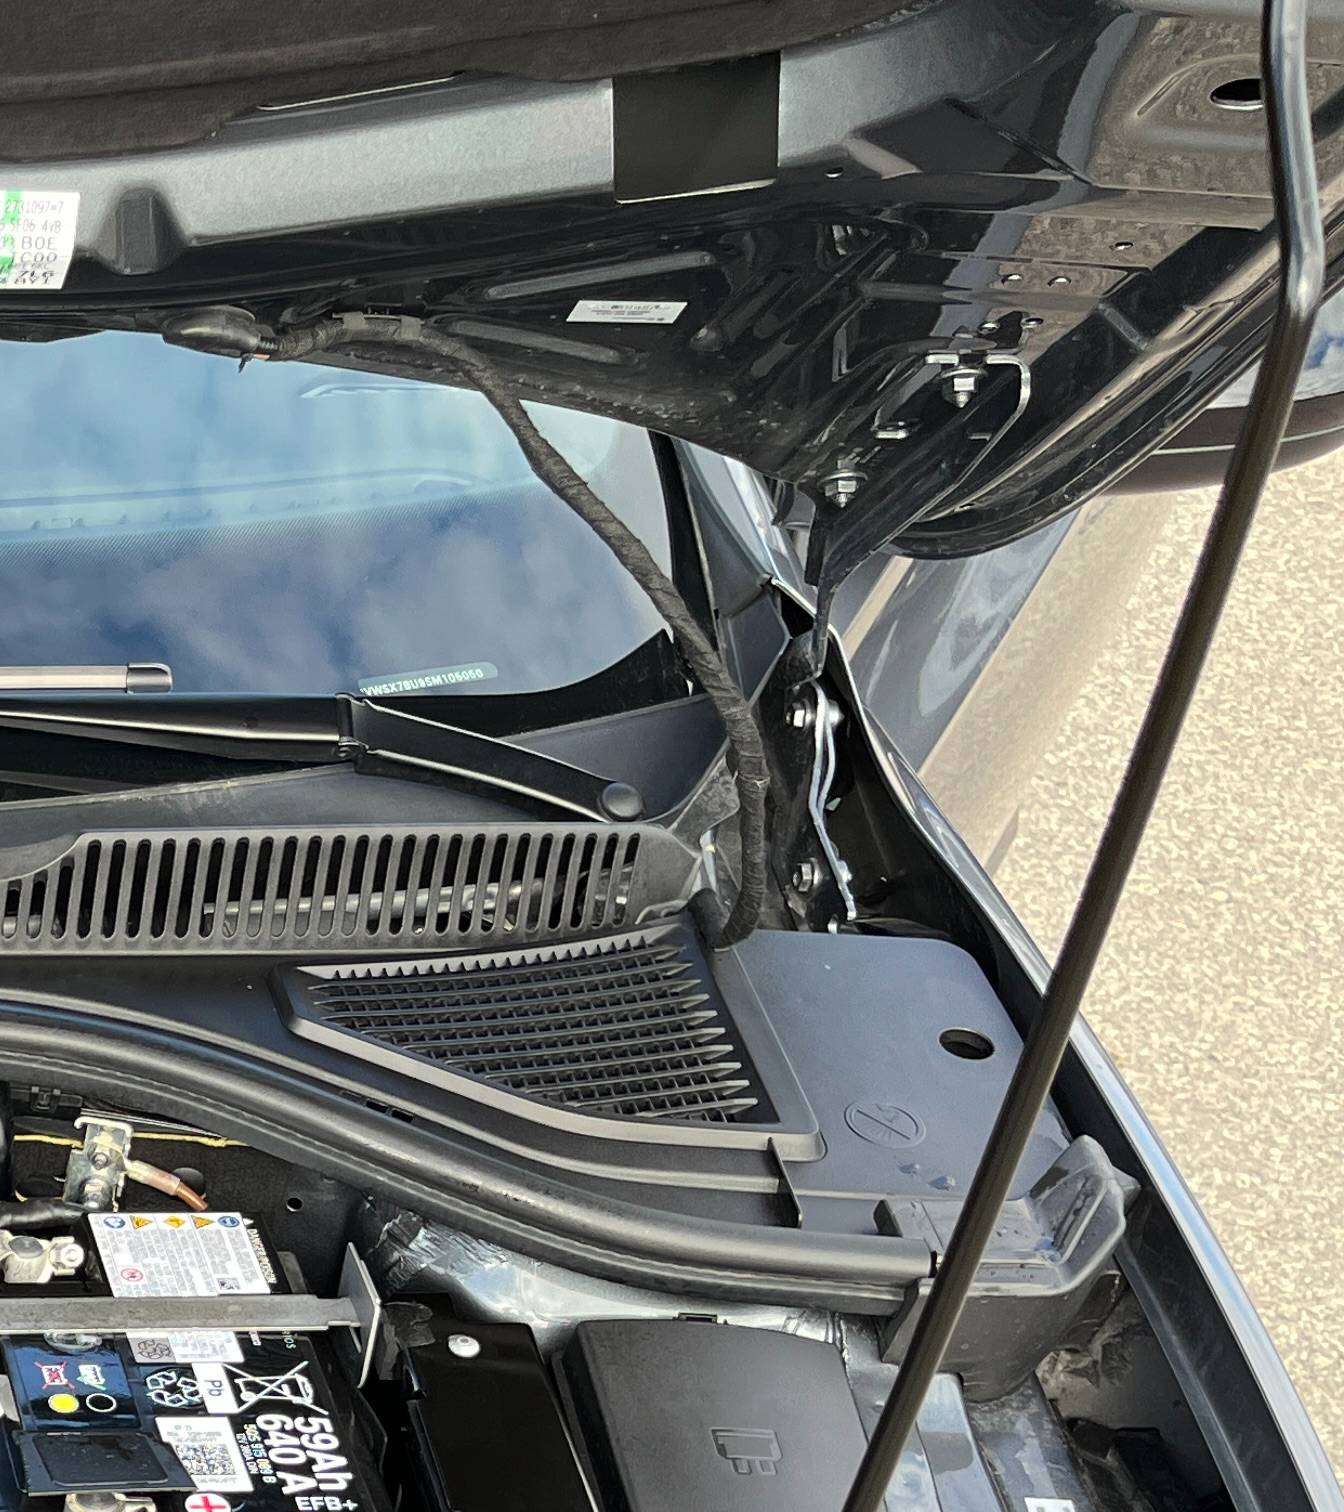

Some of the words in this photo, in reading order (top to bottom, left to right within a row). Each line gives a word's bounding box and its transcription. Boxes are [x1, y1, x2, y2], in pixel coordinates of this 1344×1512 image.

[204, 1379, 225, 1397] Pb
[256, 1413, 308, 1465] 640
[294, 1416, 354, 1492] 59Ah
[275, 1471, 318, 1495] A
[294, 1496, 360, 1511] EFB+
